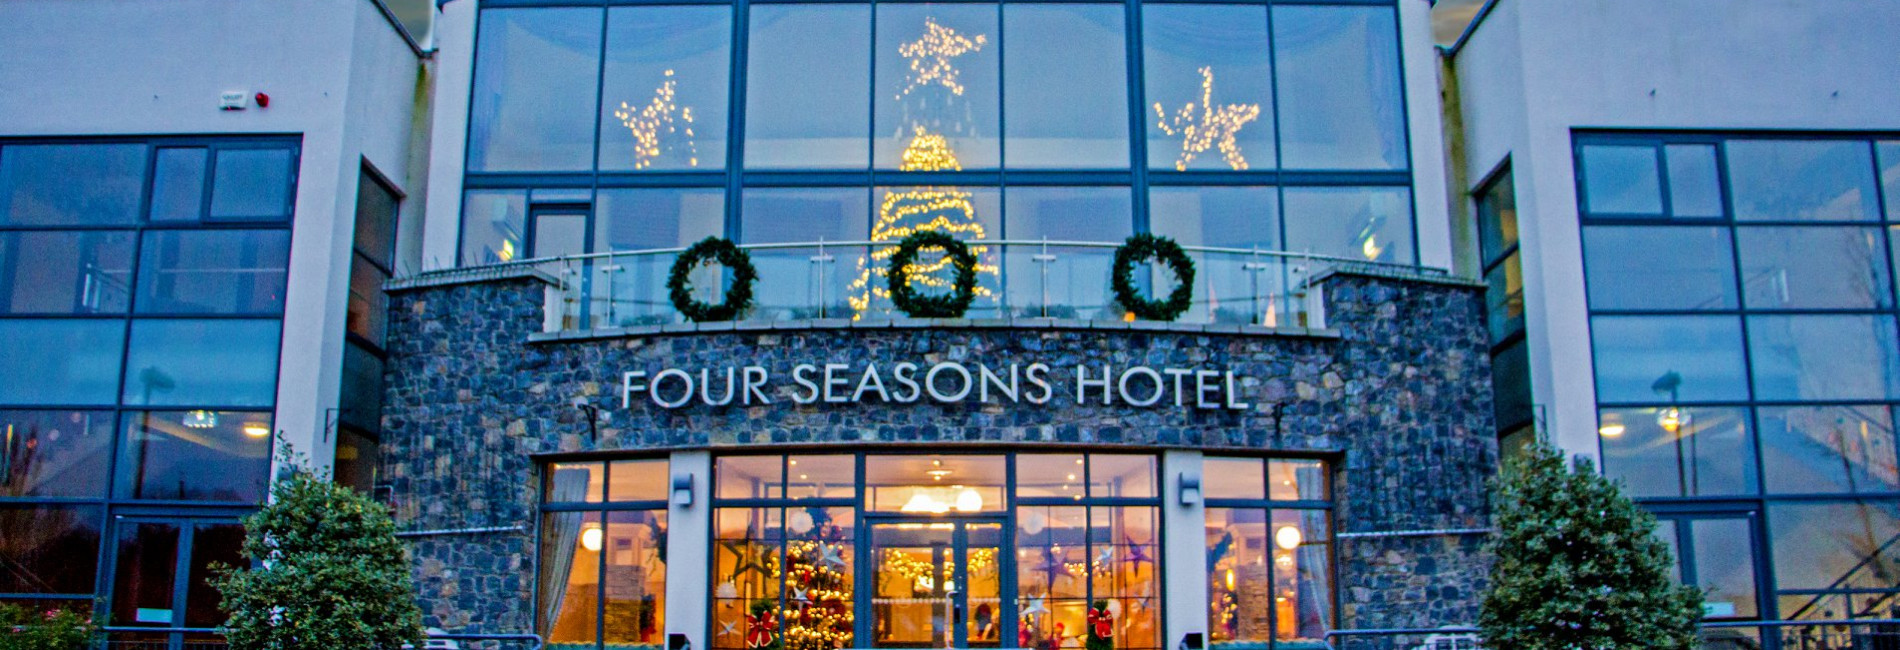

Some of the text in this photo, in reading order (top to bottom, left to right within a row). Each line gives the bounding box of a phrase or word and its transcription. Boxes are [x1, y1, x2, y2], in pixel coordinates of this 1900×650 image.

[622, 362, 1249, 409] FOUR SEASONS HOTEL
